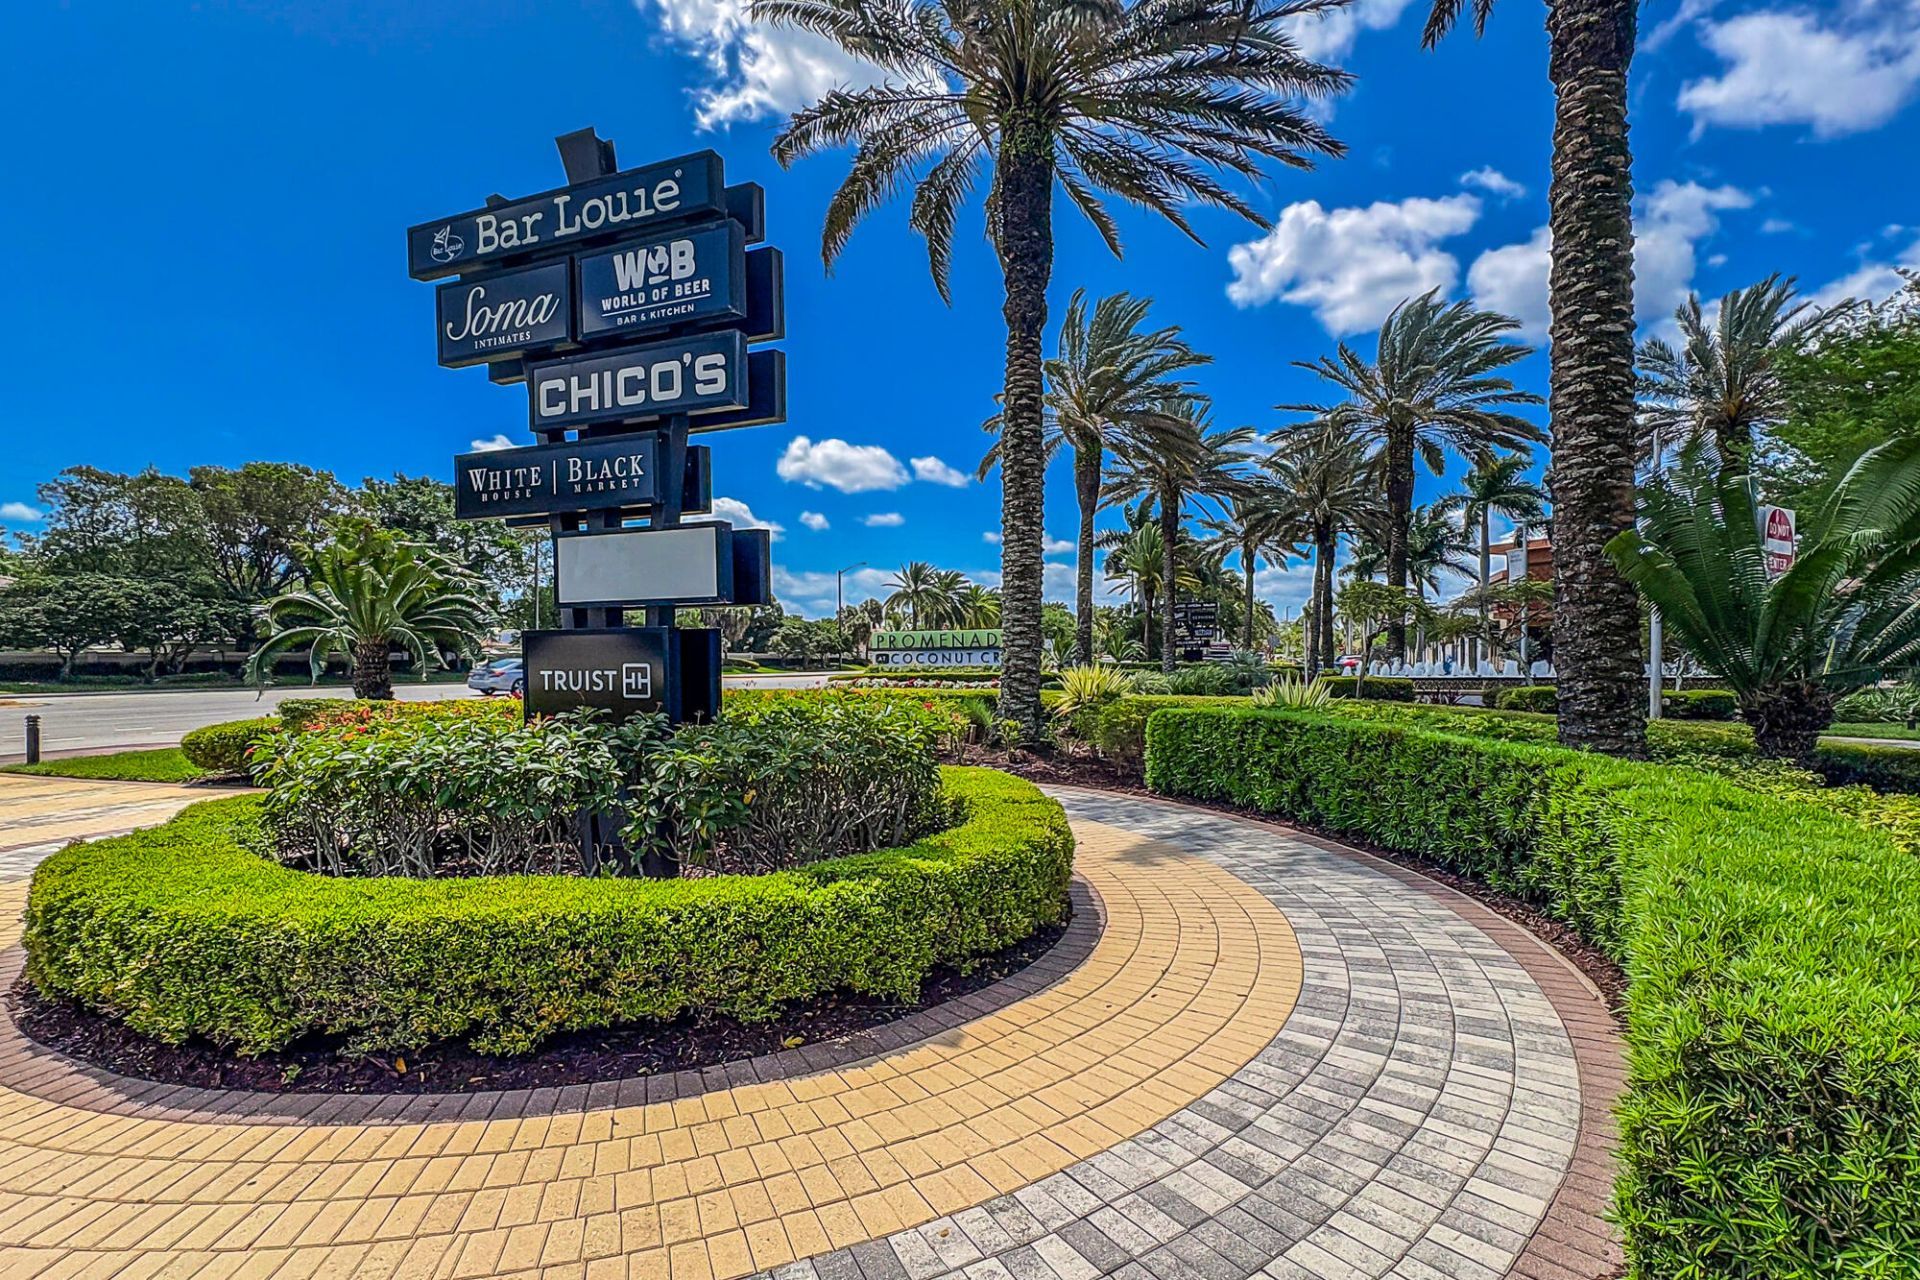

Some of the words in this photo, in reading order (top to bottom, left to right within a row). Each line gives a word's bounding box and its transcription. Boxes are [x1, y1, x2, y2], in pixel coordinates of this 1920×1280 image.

[476, 214, 544, 254] Bar
[554, 177, 681, 237] Louie
[602, 291, 646, 312] WORLD
[652, 286, 669, 301] OF
[675, 278, 711, 297] BEER
[446, 286, 560, 341] Soma
[616, 314, 638, 326] BAR
[640, 313, 647, 321] &
[650, 303, 695, 319] KITCHEN
[474, 331, 532, 350] INTIMATES
[538, 352, 728, 418] CHICO'S
[468, 466, 542, 492] WHITE
[567, 454, 645, 483] BLACK
[481, 488, 532, 502] HOUSE
[574, 478, 640, 494] MARKET
[1769, 522, 1777, 535] DO
[1777, 524, 1790, 537] NOT
[1768, 556, 1788, 570] ENTER
[876, 632, 998, 649] PROMENAD
[890, 652, 973, 664] COCONUT
[540, 669, 618, 692] TRUIST
